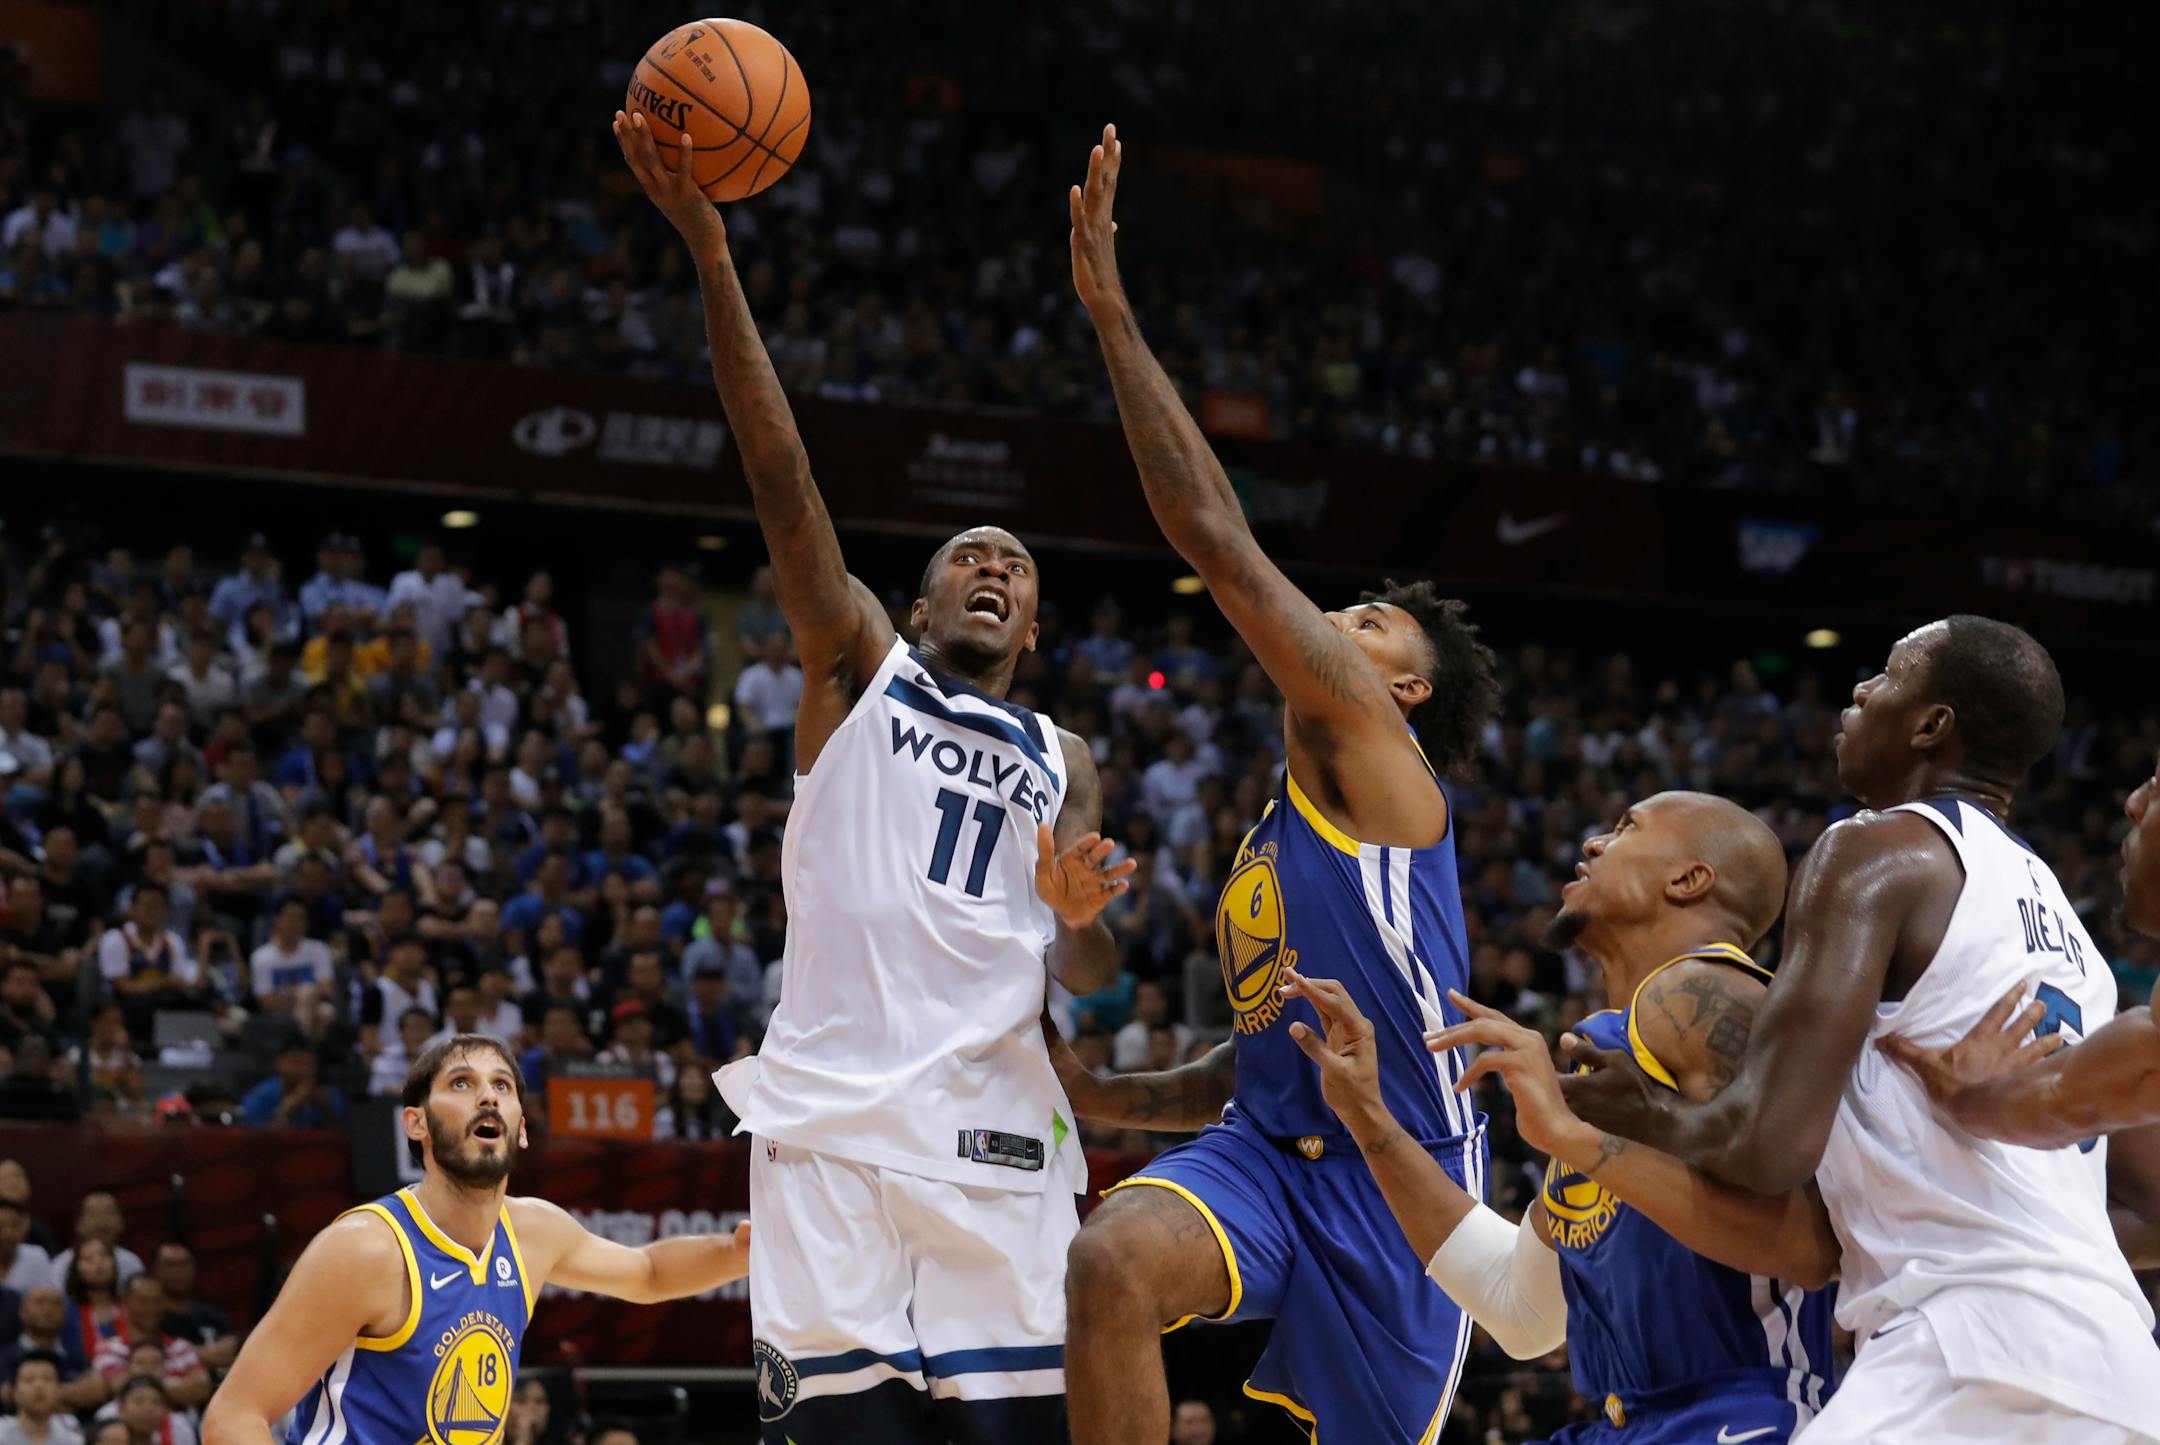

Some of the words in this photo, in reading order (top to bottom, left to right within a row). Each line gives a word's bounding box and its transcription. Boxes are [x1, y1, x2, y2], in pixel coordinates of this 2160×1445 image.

[628, 75, 692, 131] SPALD
[891, 715, 1049, 826] WOLVES
[927, 786, 1006, 898] 11
[1250, 879, 1264, 920] 6
[1233, 947, 1299, 1036] ARRIORS
[567, 1091, 640, 1132] 116
[433, 1309, 484, 1358] GOLDEN
[485, 1312, 516, 1353] STATE
[477, 1352, 498, 1388] 18
